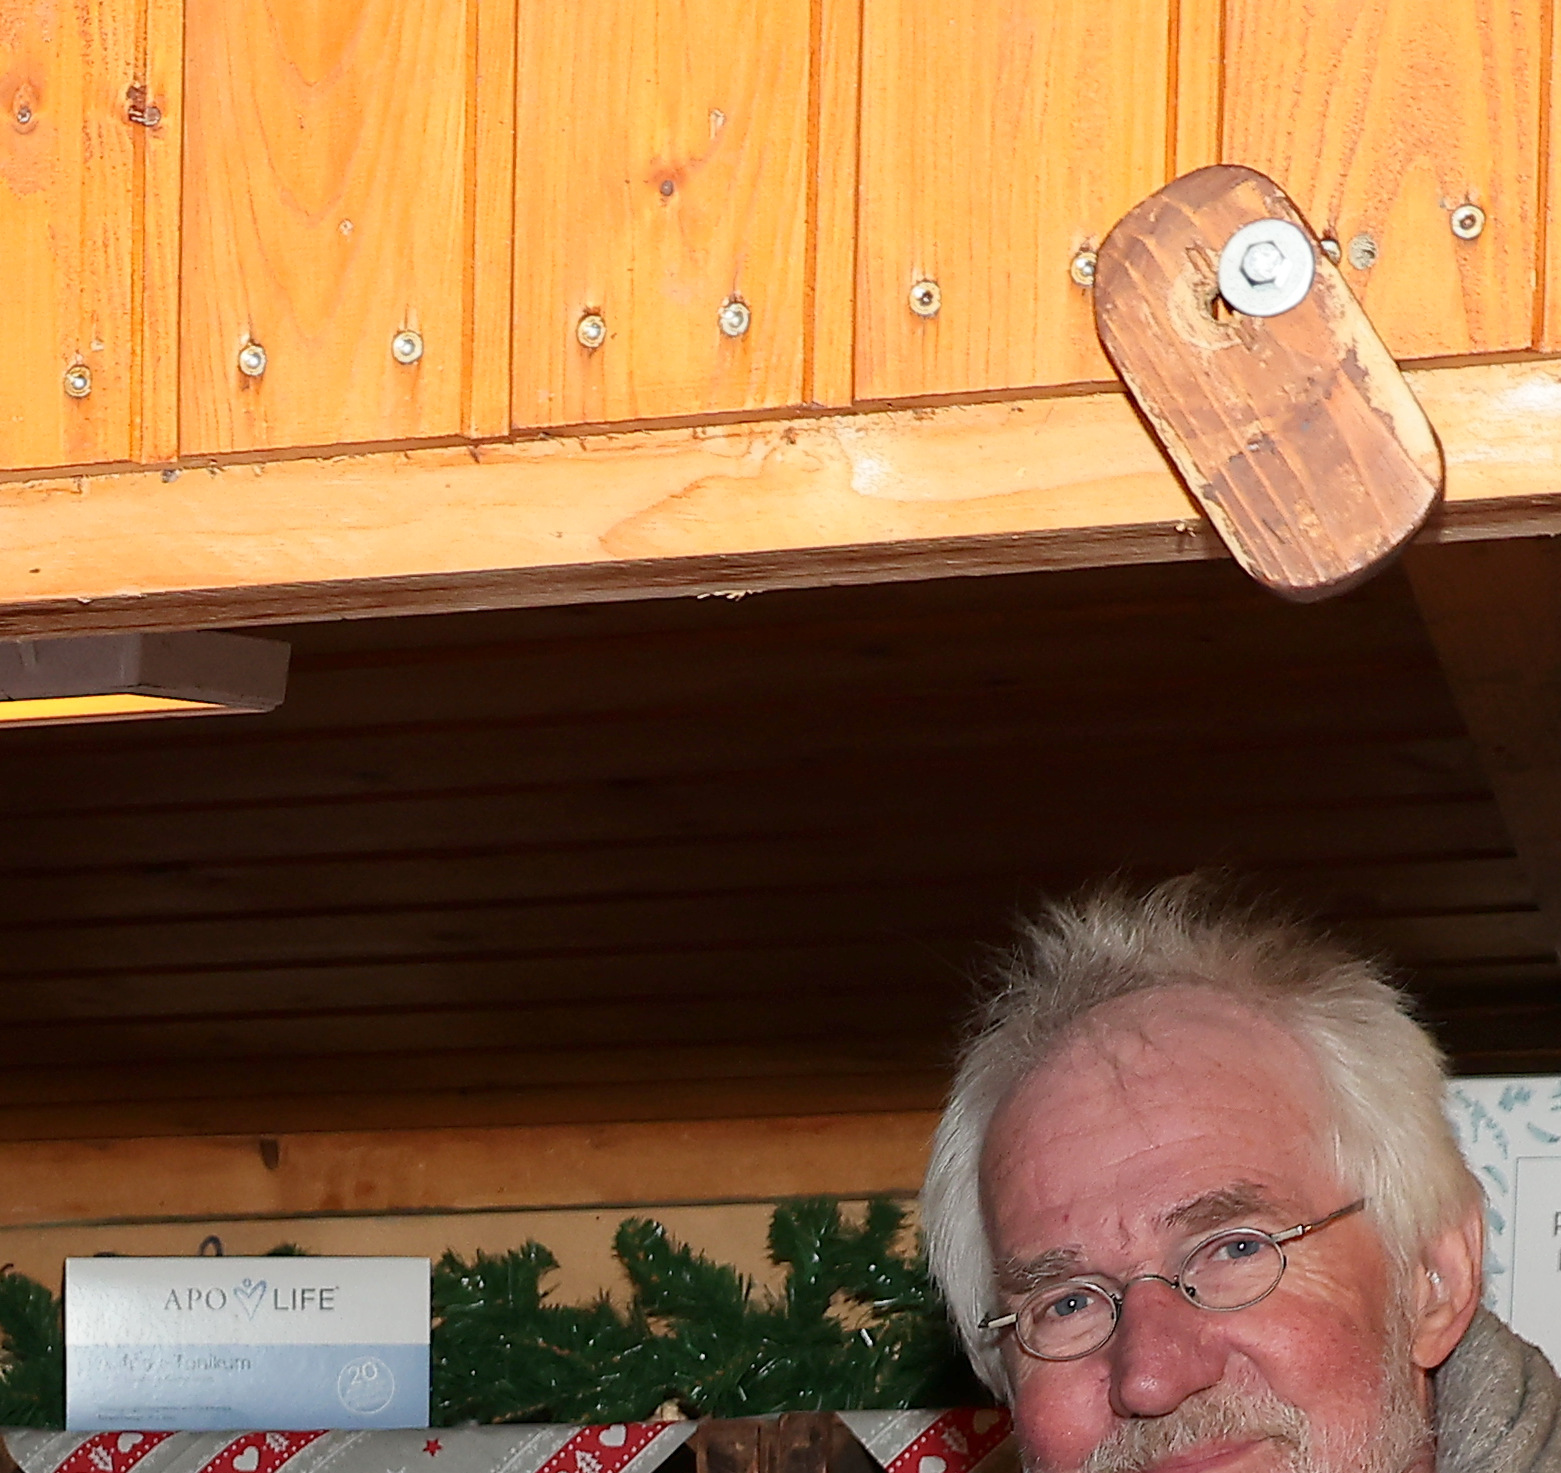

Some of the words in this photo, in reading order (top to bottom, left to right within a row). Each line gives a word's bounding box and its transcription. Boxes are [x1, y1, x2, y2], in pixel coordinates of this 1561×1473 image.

[164, 1288, 227, 1311] APO
[273, 1288, 335, 1311] LIFE
[346, 1364, 379, 1386] 20
